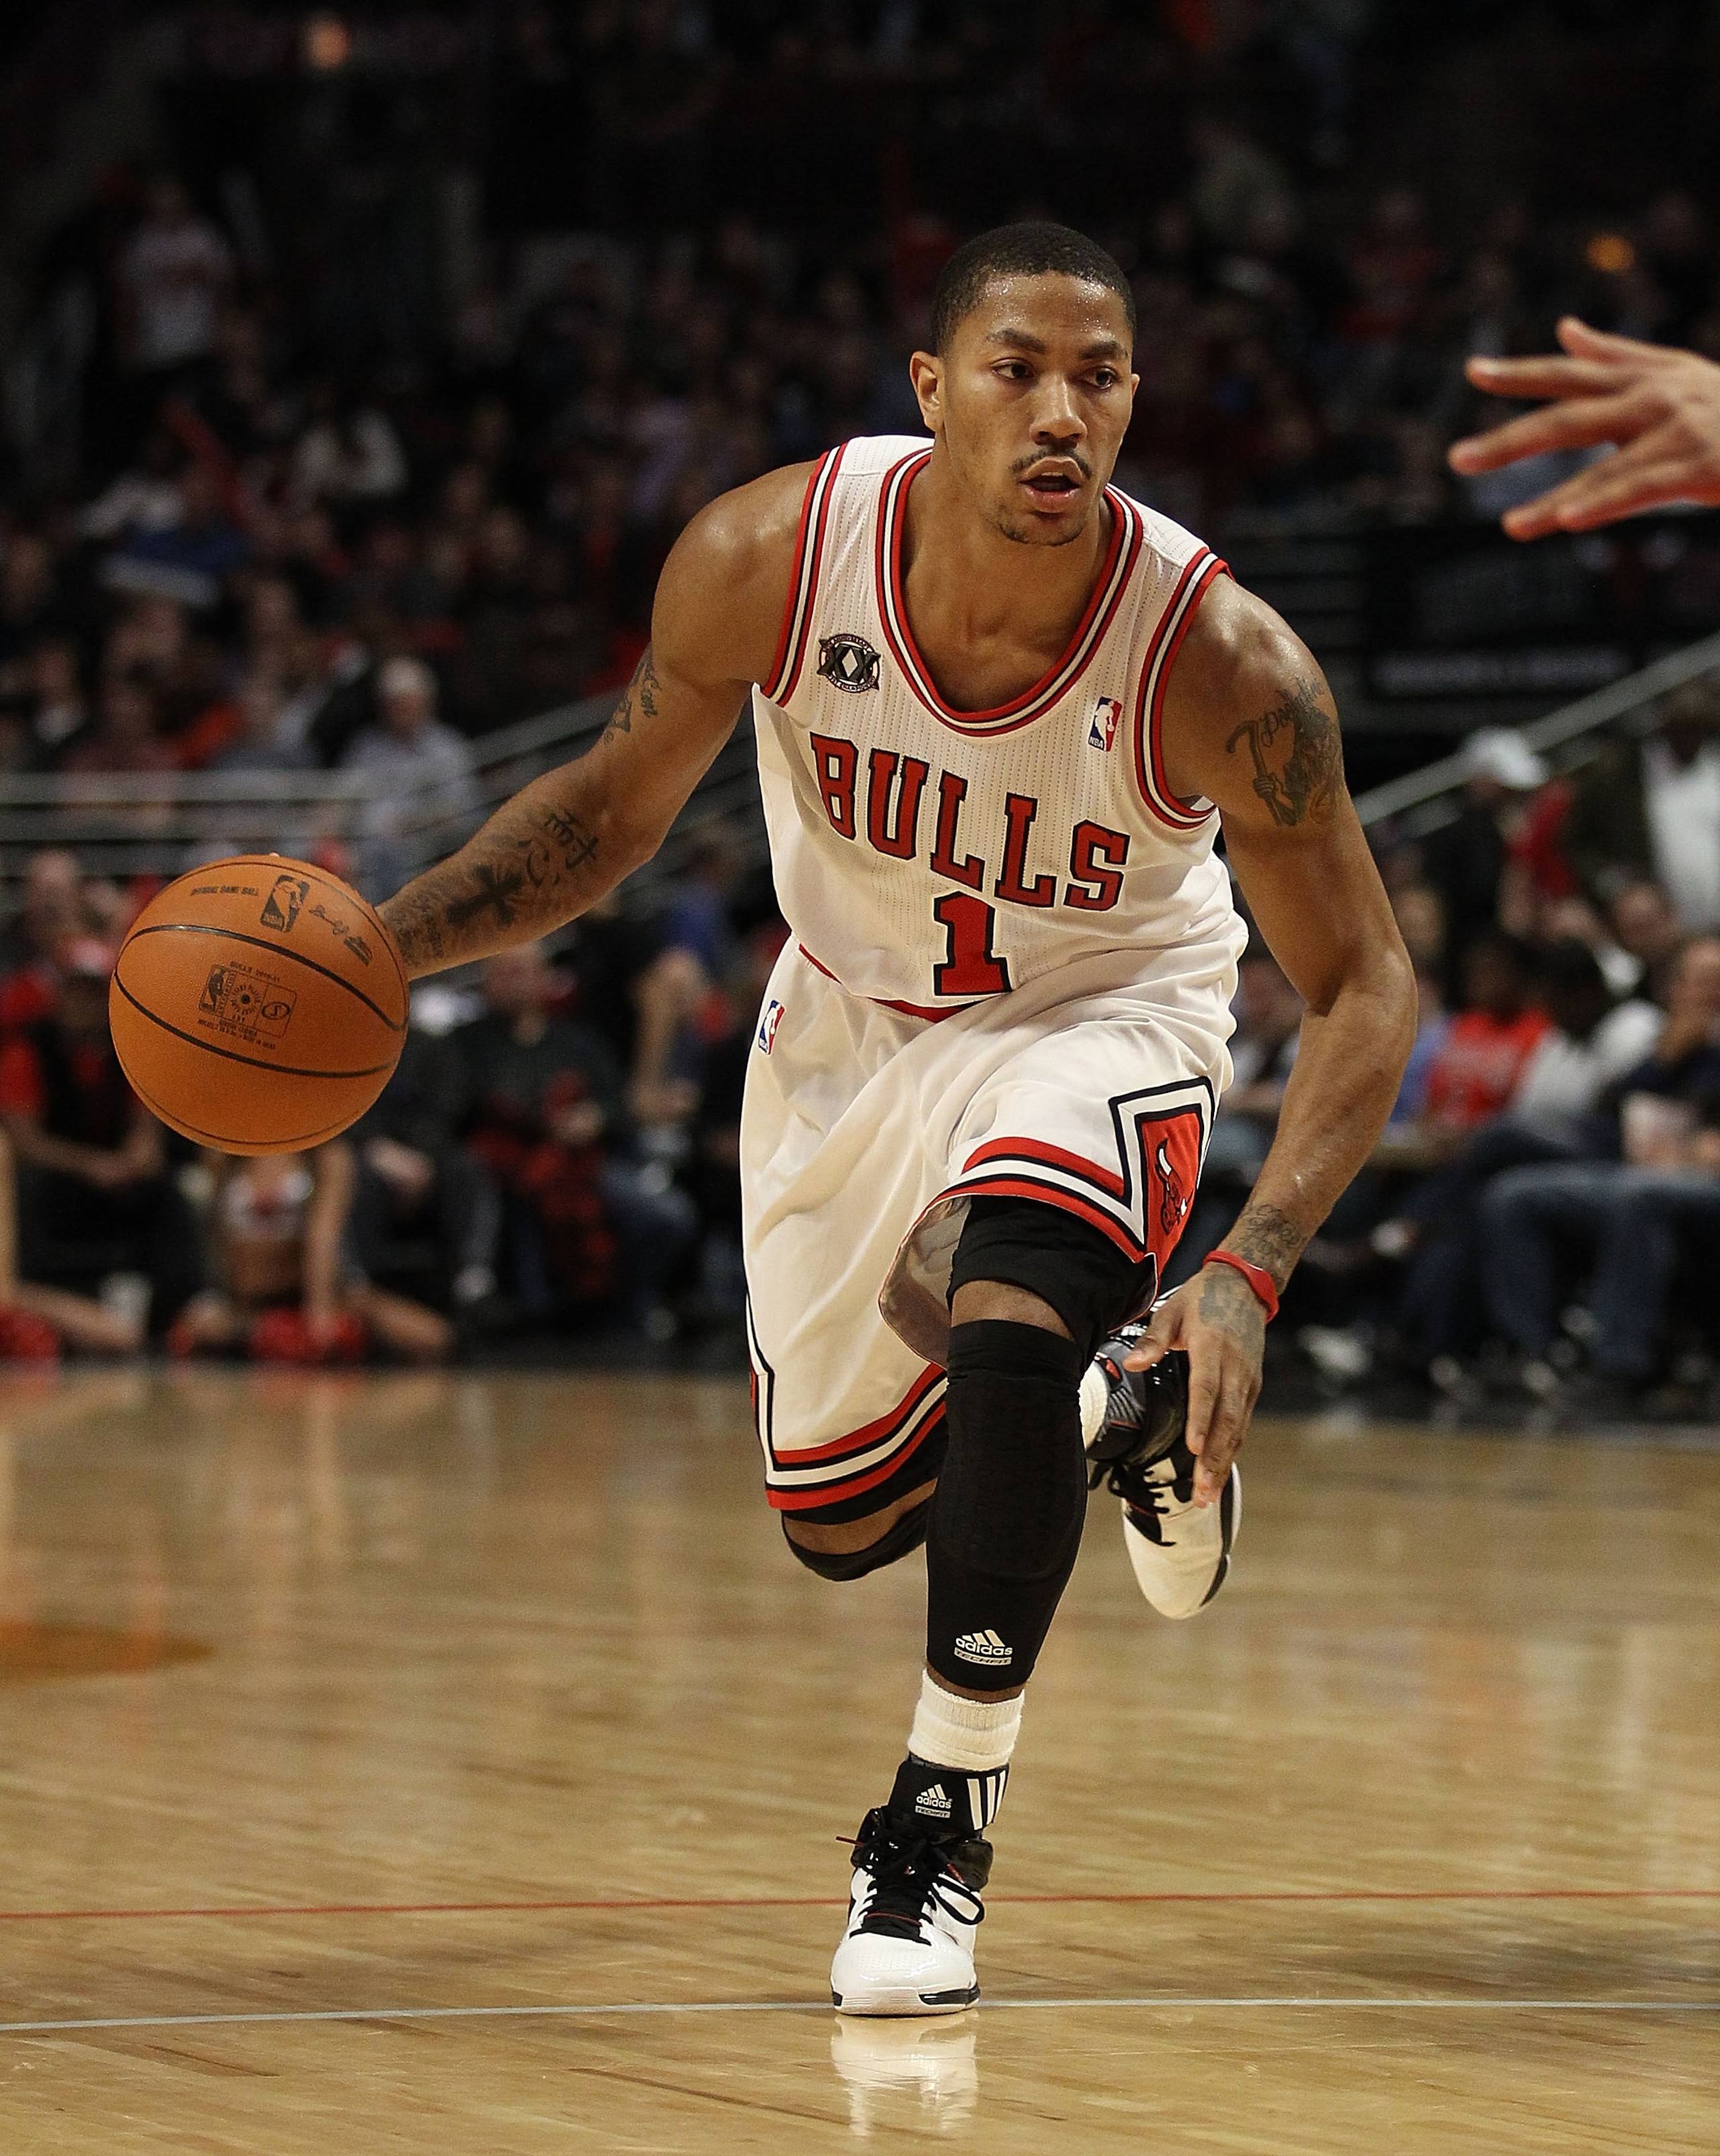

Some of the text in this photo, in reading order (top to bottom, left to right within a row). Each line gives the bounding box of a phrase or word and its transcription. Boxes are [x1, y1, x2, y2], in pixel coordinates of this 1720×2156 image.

[1089, 737, 1104, 748] NBA
[810, 731, 1131, 912] BULLS
[933, 890, 1014, 997] 1
[955, 1638, 1013, 1656] adidas
[916, 1796, 952, 1809] adidas
